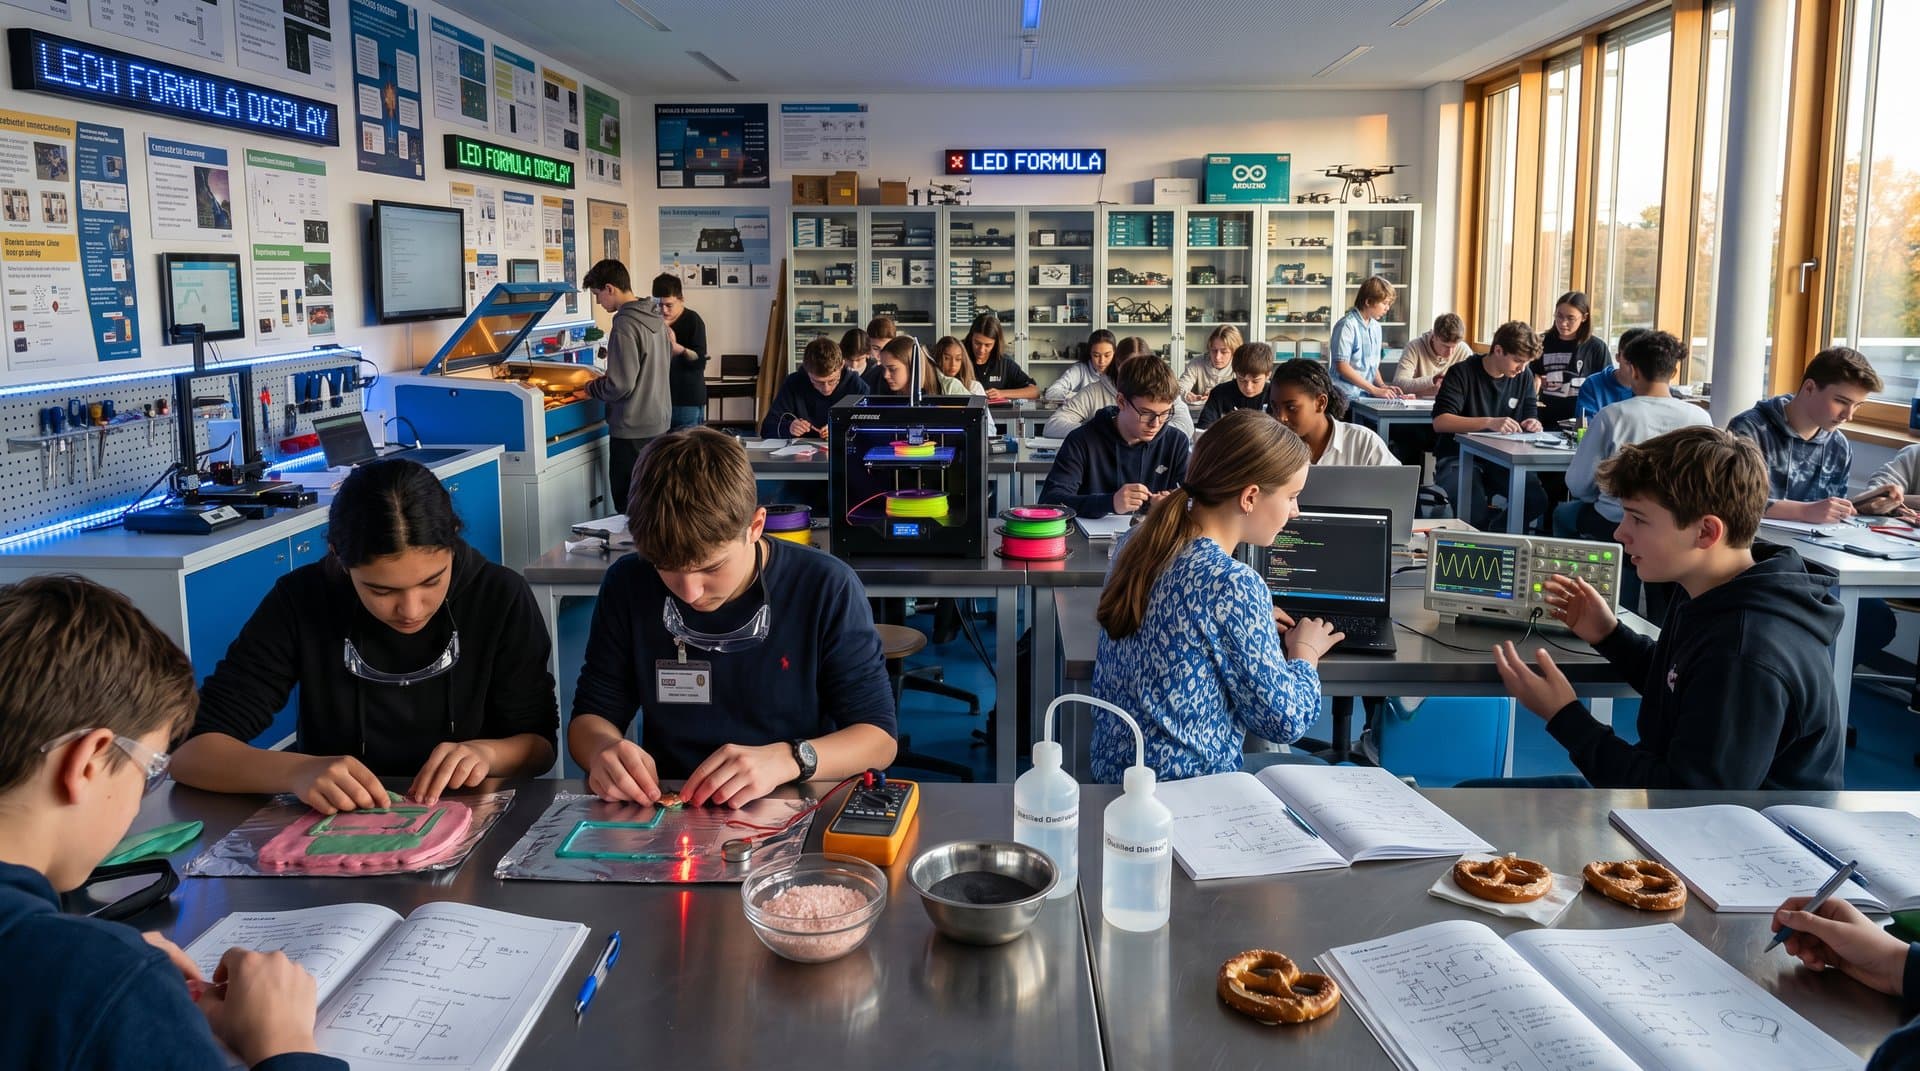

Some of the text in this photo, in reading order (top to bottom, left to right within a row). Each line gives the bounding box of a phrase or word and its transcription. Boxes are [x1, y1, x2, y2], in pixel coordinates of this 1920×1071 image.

[130, 64, 240, 119] FORMULA
[248, 92, 328, 136] DISPLAY
[459, 142, 571, 183] LED FORMULA DISPLAY
[971, 152, 1008, 171] LED
[1015, 152, 1102, 171] FORMULA
